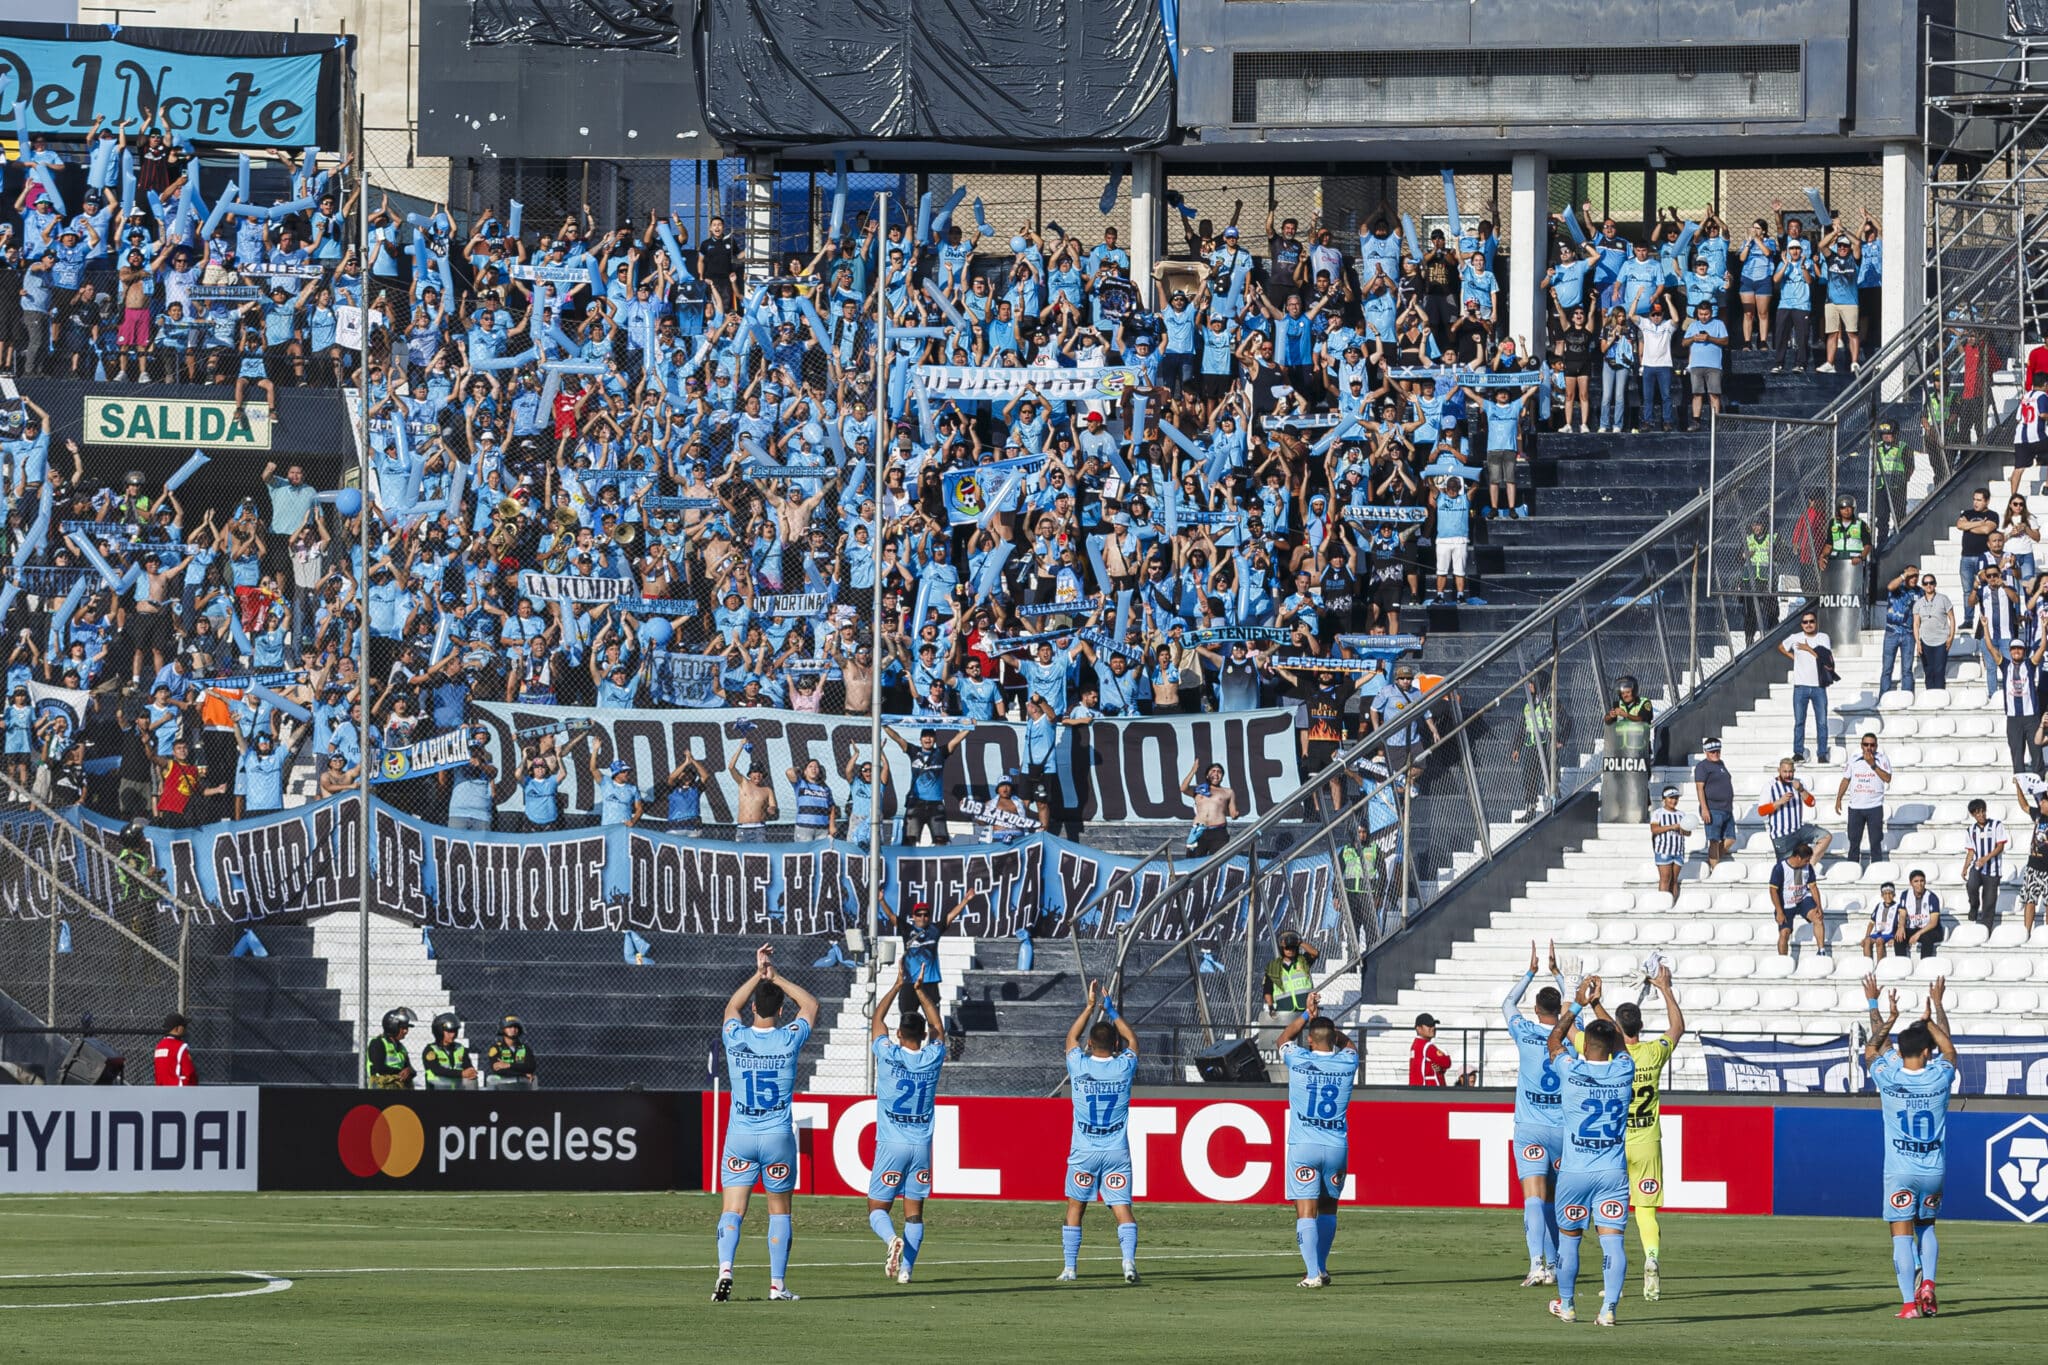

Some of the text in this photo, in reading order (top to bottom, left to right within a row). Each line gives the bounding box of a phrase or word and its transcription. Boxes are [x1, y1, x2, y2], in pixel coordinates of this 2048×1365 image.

[0, 48, 303, 140] Del Norte
[100, 402, 255, 443] SALIDA
[1351, 506, 1408, 521] REALES
[525, 575, 551, 598] LA
[1819, 594, 1861, 608] POLICIA
[1182, 627, 1293, 647] LA TENIENTE
[412, 729, 471, 771] KAPUCHA
[1603, 757, 1647, 772] POLICIA
[960, 797, 983, 814] LOS
[213, 796, 365, 924] CIUDAD
[375, 808, 427, 919] DE
[432, 836, 624, 932] IQUIQUE,
[629, 833, 770, 936] DONDE
[782, 849, 886, 937] HAY
[897, 843, 1044, 939] FIESTA
[1055, 850, 1099, 939] Y
[735, 1058, 786, 1070] RODRIGUEZ
[890, 1068, 936, 1081] FERNANDEZ
[1307, 1075, 1343, 1087] SALINAS
[1540, 1058, 1561, 1092] 8
[742, 1070, 780, 1110] 15
[1084, 1082, 1126, 1094] GONZALEZ
[1589, 1088, 1619, 1099] HOYOS
[892, 1079, 928, 1115] 21
[1306, 1083, 1340, 1120] 18
[1905, 1098, 1930, 1110] PUGH
[1086, 1094, 1119, 1128] 17
[1578, 1098, 1624, 1139] 23
[1896, 1109, 1936, 1141] 10
[439, 1111, 638, 1173] priceless
[1528, 1147, 1540, 1158] PF
[732, 1159, 745, 1169] PF
[1449, 1112, 1728, 1209] TL
[771, 1166, 785, 1177] PF
[1299, 1169, 1312, 1179] PF
[886, 1174, 899, 1184] PF
[1078, 1174, 1090, 1185] PF
[1109, 1176, 1122, 1186] PF
[1643, 1181, 1656, 1192] PF
[1896, 1194, 1907, 1205] PF
[1569, 1207, 1582, 1218] PF
[1605, 1204, 1619, 1216] PF
